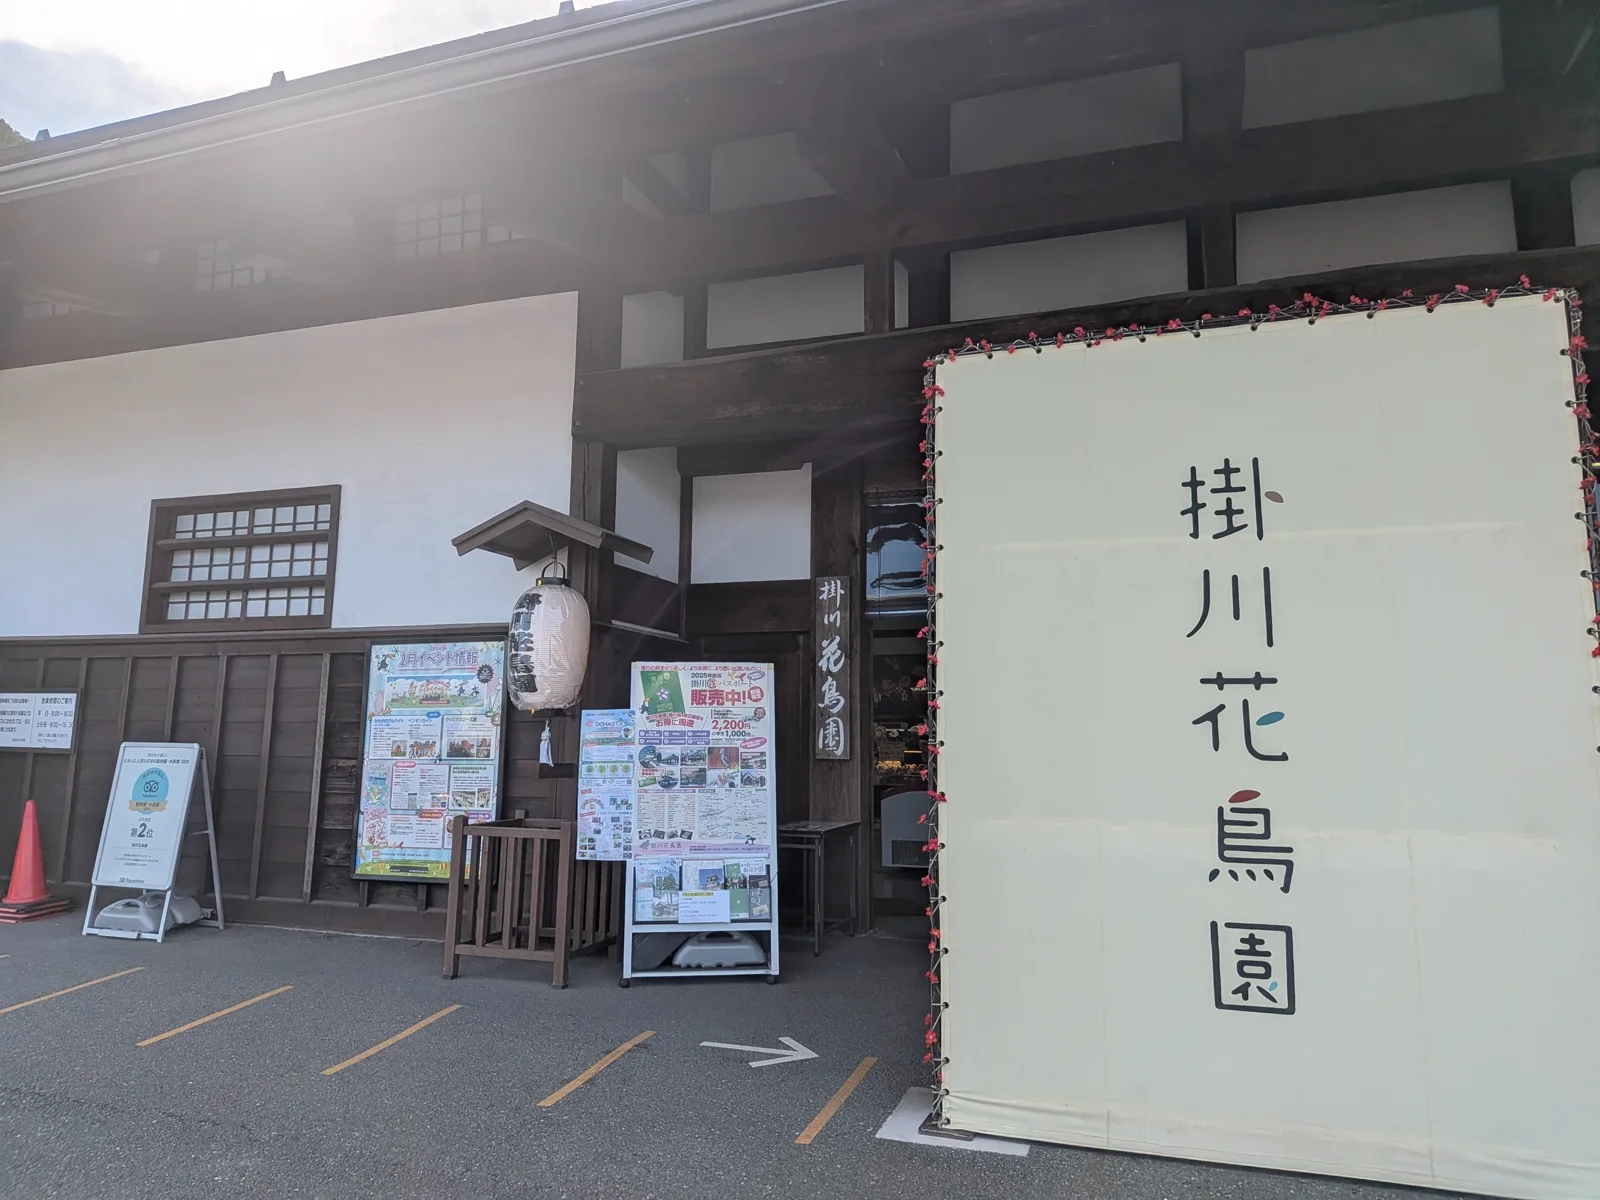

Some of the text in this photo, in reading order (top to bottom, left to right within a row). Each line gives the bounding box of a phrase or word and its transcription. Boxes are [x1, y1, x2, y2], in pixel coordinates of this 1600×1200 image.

[399, 650, 478, 667] 2月イベント情報
[818, 579, 845, 756] 掛川花鳥園
[690, 689, 747, 706] 販売中!
[712, 720, 751, 731] 2,200円
[725, 730, 751, 738] 1,000円
[1180, 457, 1296, 1015] 掛川花鳥園
[130, 822, 154, 838] 第2位
